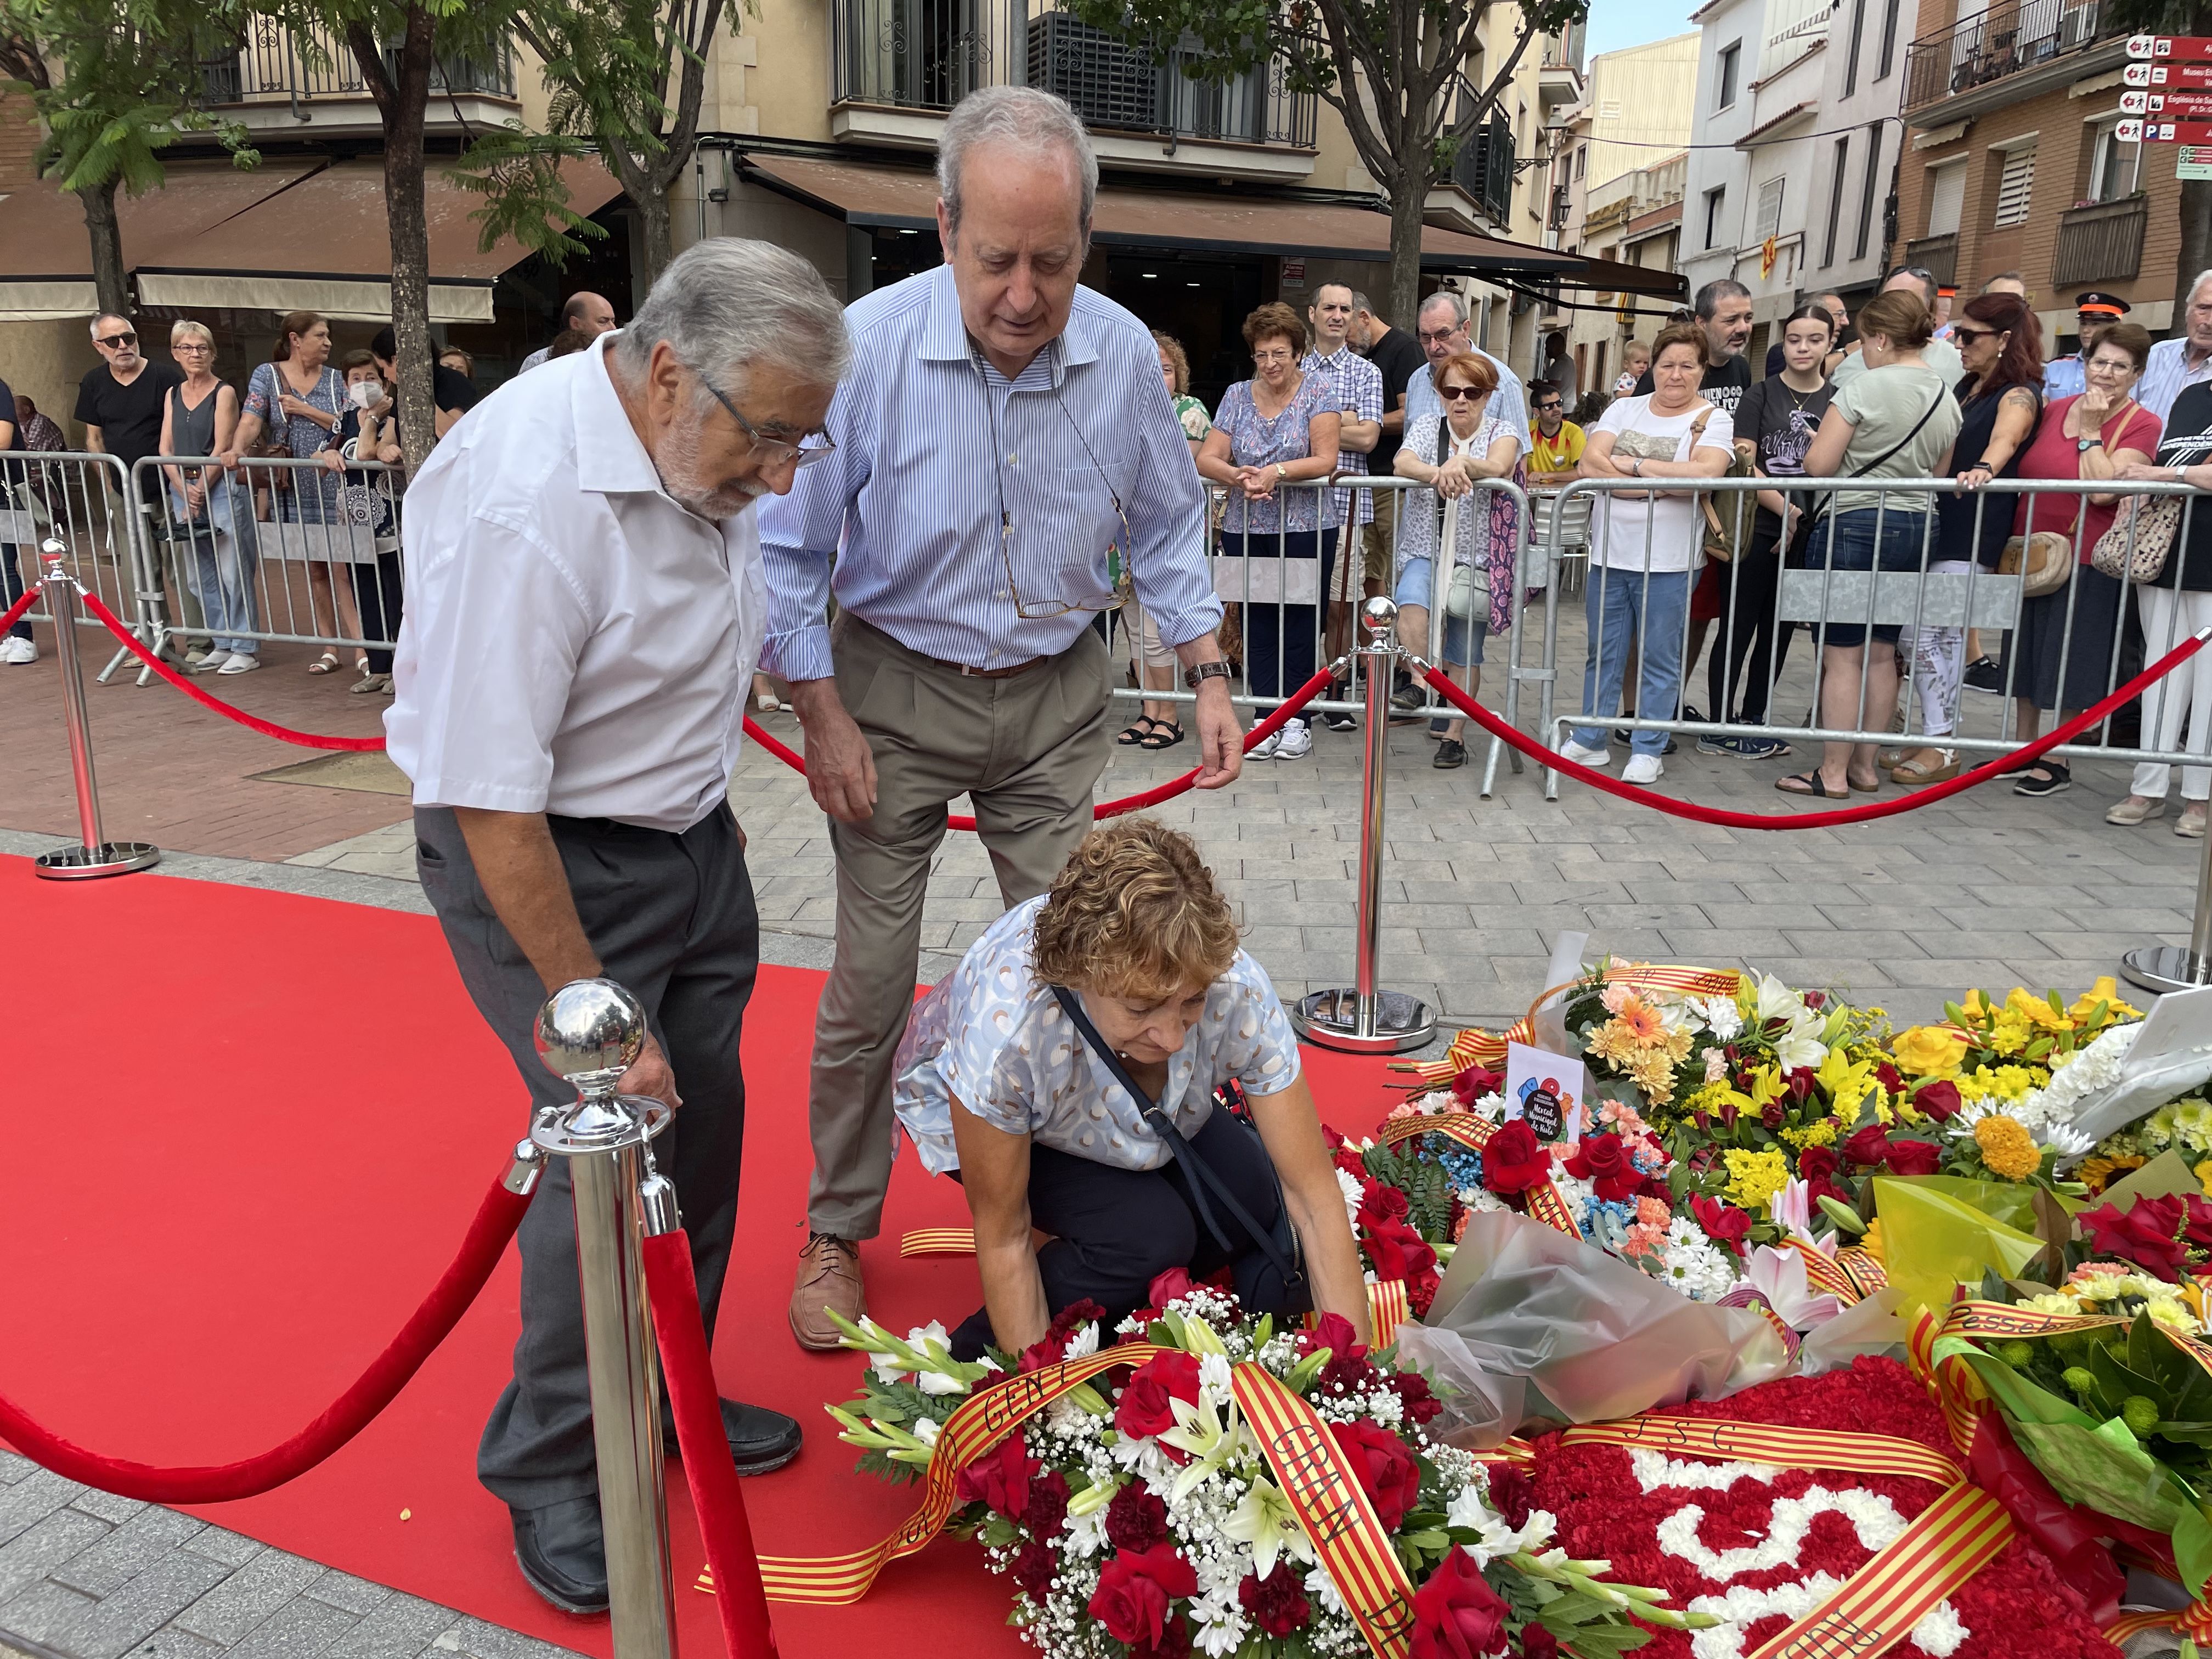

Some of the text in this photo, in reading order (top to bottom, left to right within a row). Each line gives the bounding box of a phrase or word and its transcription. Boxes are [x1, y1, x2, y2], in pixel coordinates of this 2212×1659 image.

[1528, 1110, 1558, 1127] Municipal
[1533, 1103, 1554, 1118] Mercat
[1531, 1120, 1539, 1131] de
[984, 1361, 1075, 1432] GENT
[1272, 1425, 1365, 1548] GRAN
